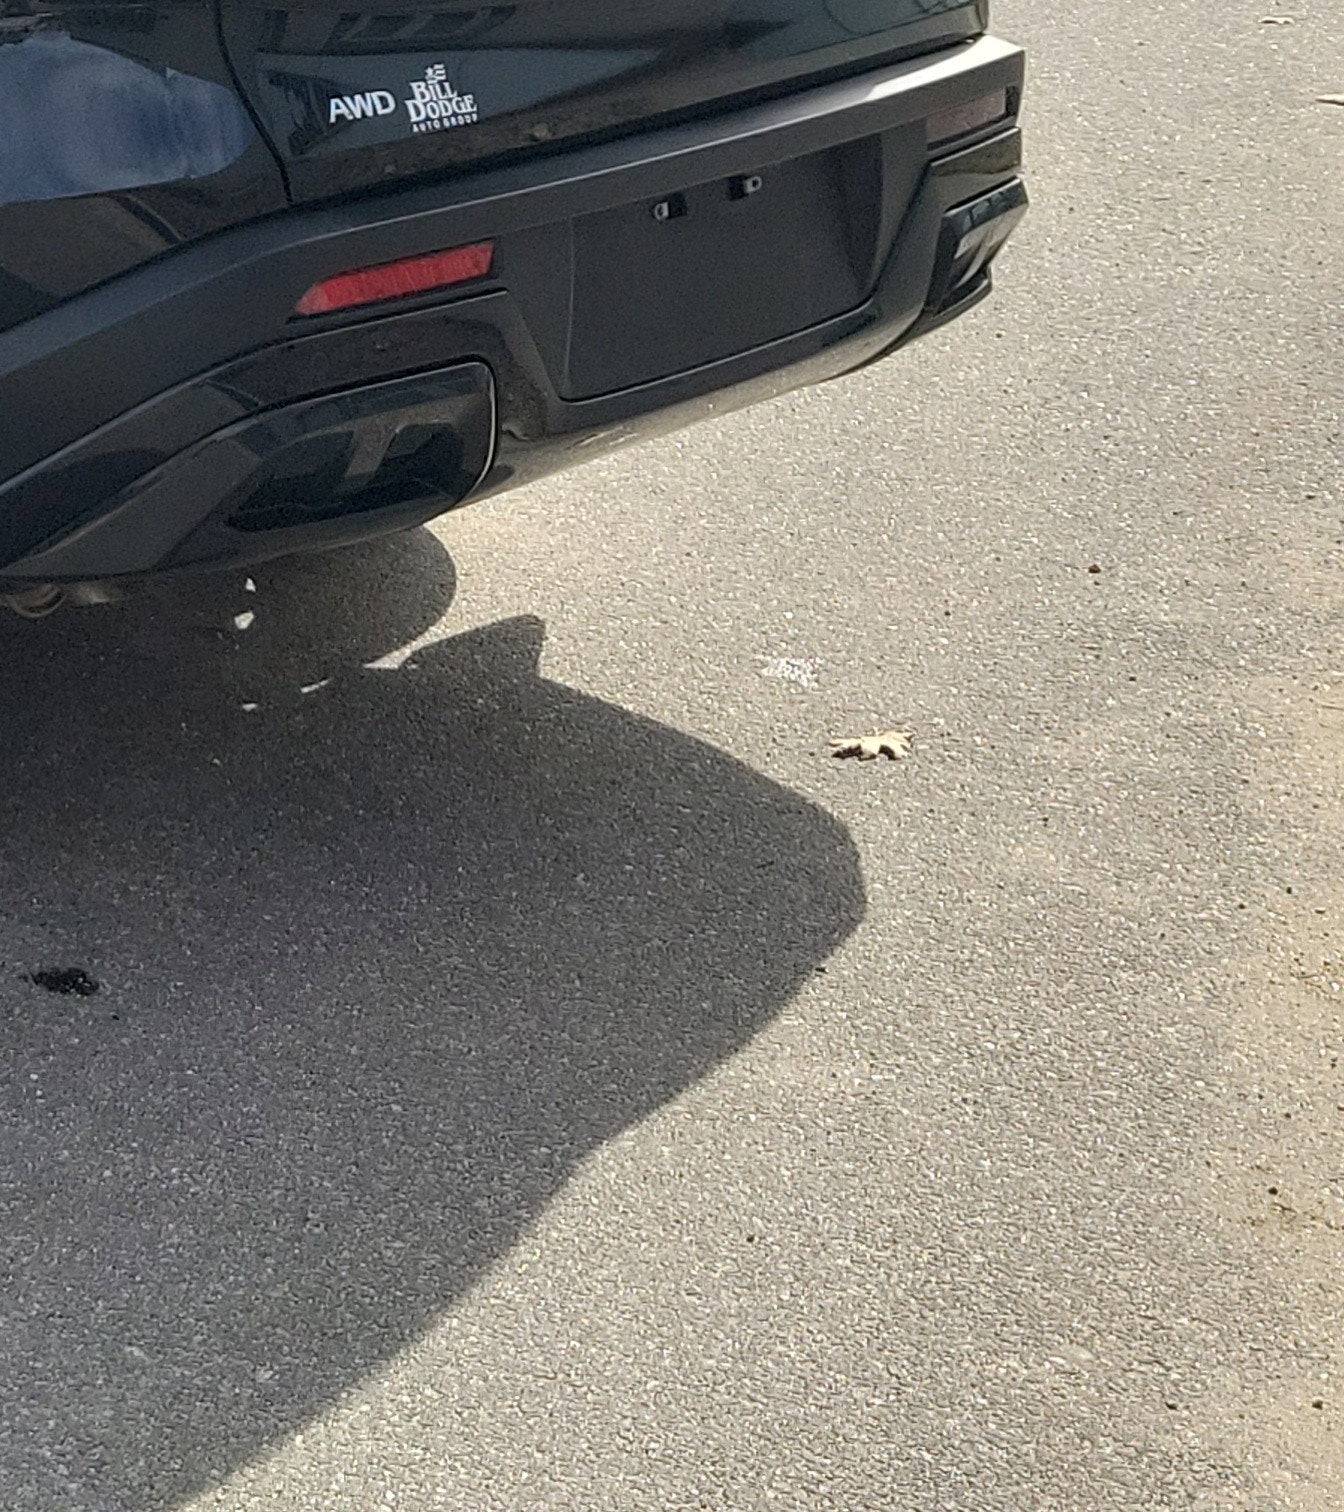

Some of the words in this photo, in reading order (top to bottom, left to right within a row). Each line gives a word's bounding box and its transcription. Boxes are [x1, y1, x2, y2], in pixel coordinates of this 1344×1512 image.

[409, 81, 458, 103] BILL
[329, 90, 396, 124] AWD
[404, 94, 478, 122] DODGE
[412, 119, 441, 133] AUTO
[442, 113, 478, 127] GROUP
